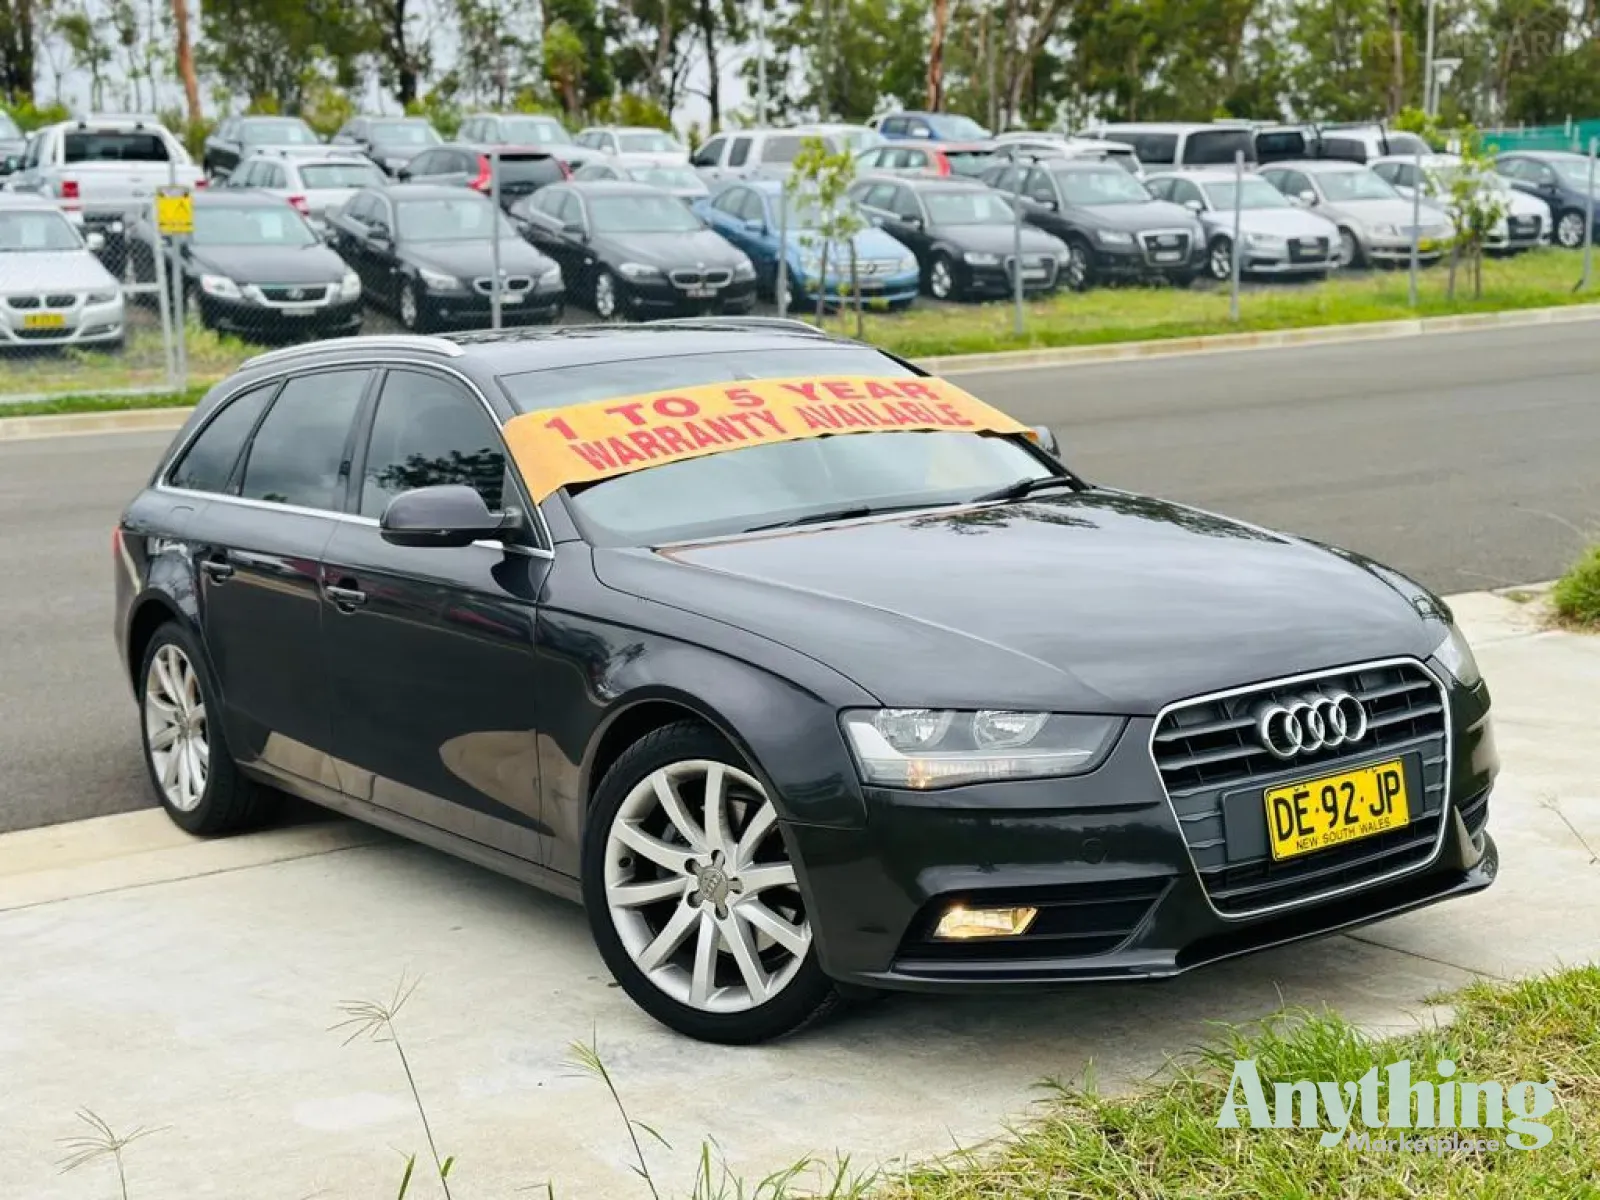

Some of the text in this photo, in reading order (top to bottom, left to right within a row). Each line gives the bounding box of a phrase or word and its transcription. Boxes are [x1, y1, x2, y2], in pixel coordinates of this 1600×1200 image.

[544, 381, 940, 440] 1 TO 5 YEAR
[568, 402, 975, 471] WARRANTY AVAILABLE
[1297, 817, 1391, 850] NEW SOUTH WALES
